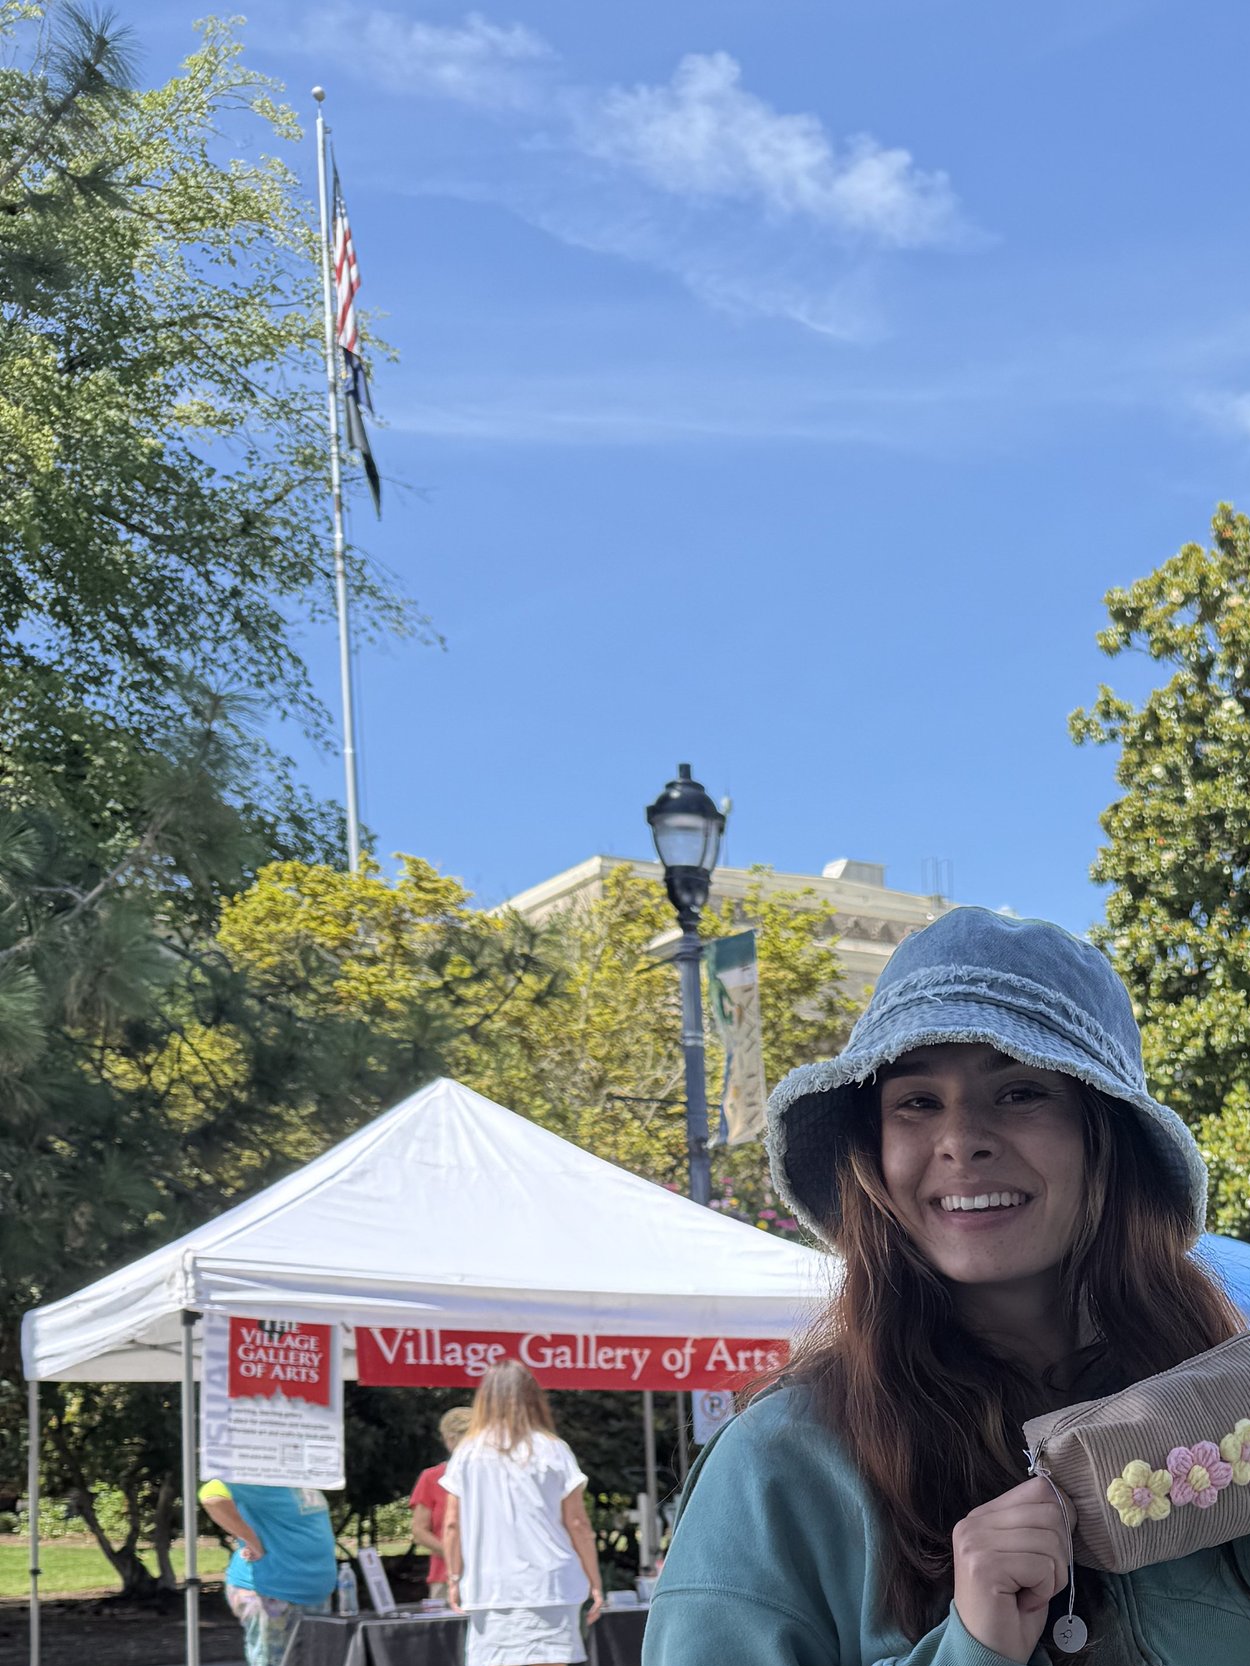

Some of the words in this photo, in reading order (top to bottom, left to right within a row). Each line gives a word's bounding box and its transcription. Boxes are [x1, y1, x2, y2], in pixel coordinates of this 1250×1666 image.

[264, 1319, 300, 1333] THE
[241, 1327, 319, 1351] VILLAGE
[237, 1343, 323, 1368] GALLERY
[369, 1327, 506, 1377] Village
[519, 1333, 652, 1381] Gallery
[661, 1338, 697, 1380] of
[704, 1338, 781, 1372] Arts
[239, 1362, 265, 1379] OF
[270, 1364, 320, 1384] ARTS
